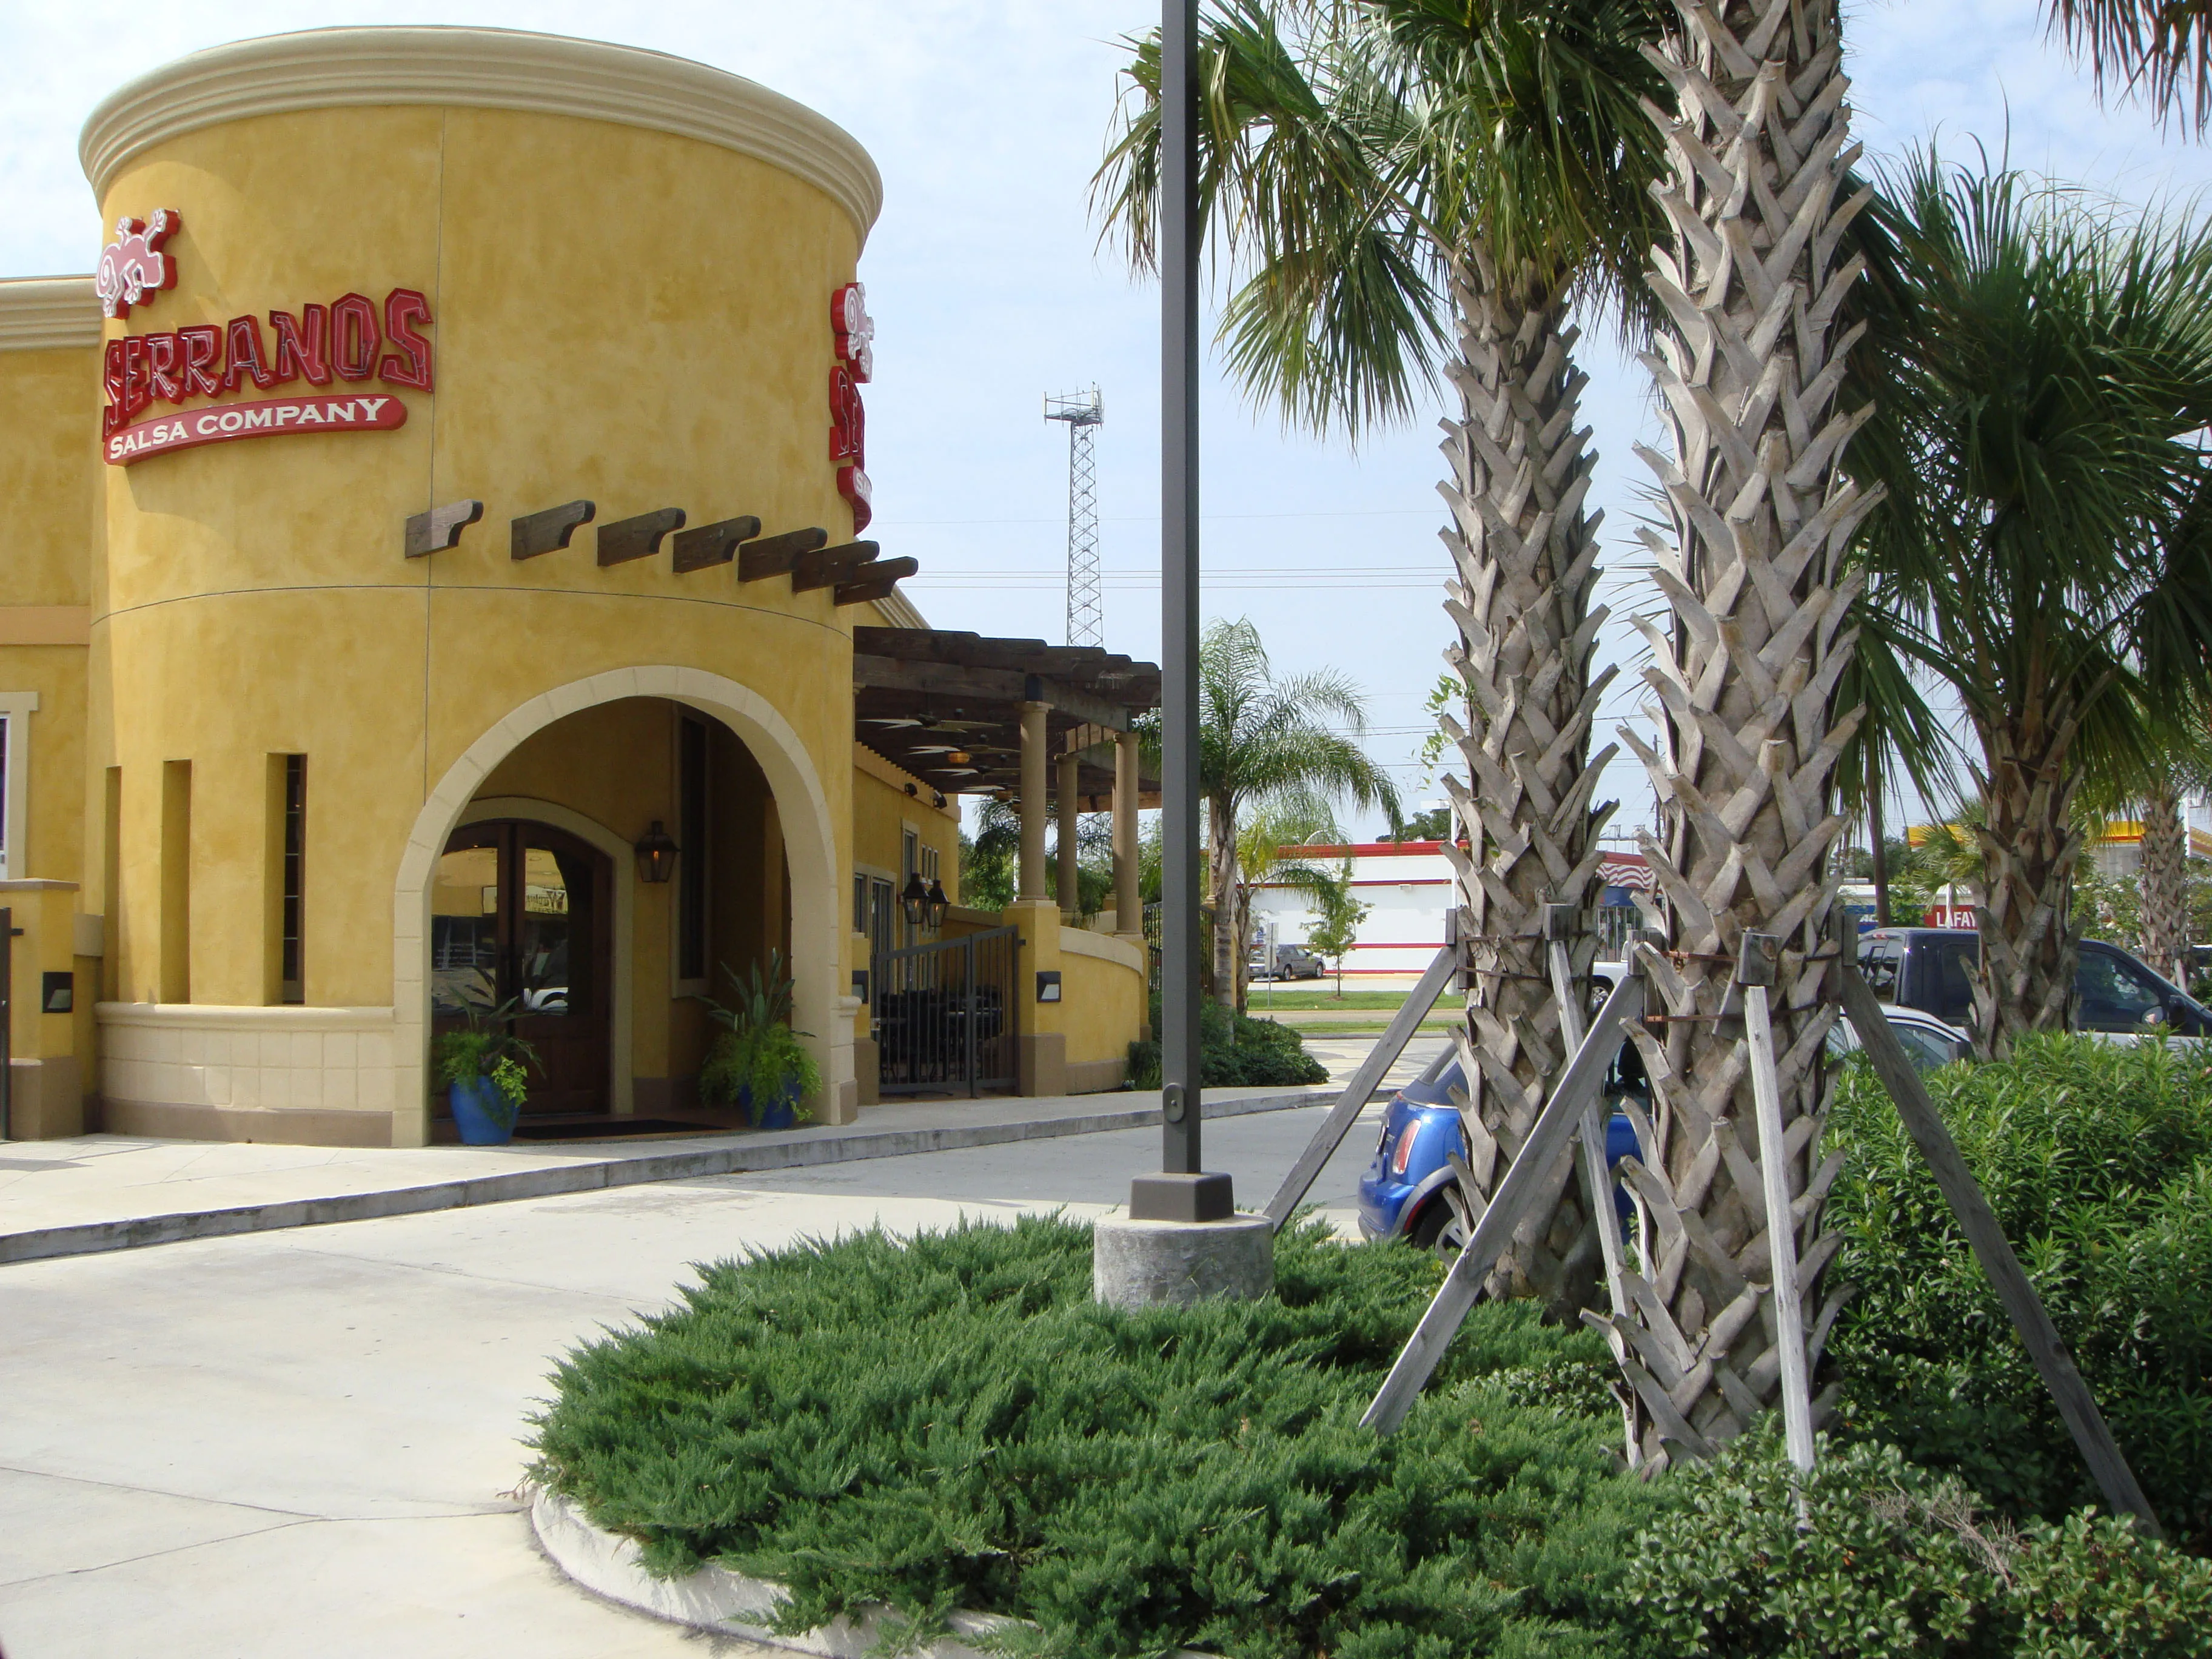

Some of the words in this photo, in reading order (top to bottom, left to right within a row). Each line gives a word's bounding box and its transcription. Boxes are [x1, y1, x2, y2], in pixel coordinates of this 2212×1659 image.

[103, 287, 434, 442] SERRANOS
[110, 421, 189, 460] SALSA
[196, 398, 389, 435] COMPANY
